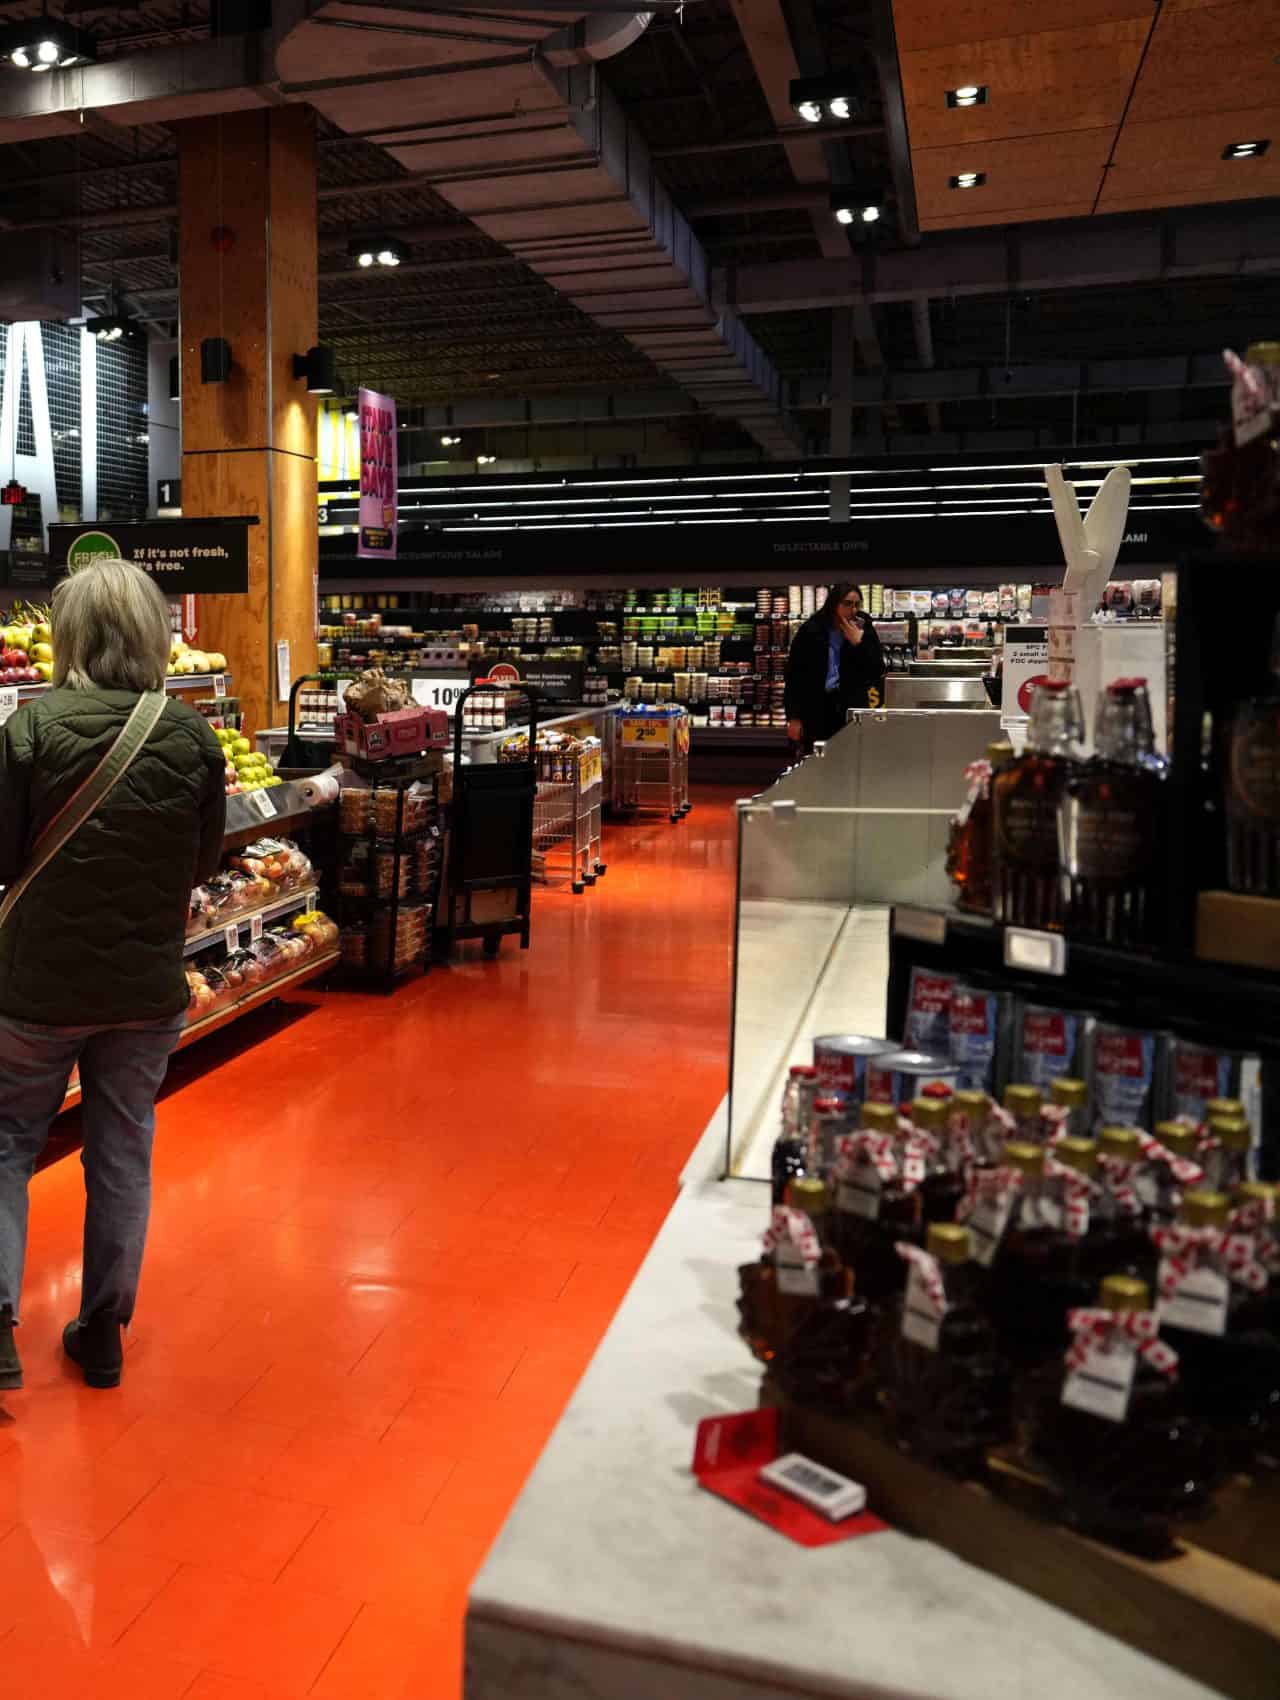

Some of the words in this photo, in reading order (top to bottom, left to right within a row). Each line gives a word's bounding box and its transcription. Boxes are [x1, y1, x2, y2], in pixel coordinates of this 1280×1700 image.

[160, 484, 170, 503] 1
[318, 507, 328, 523] 3
[133, 548, 145, 559] If
[147, 548, 167, 558] it's
[169, 547, 190, 558] not
[192, 545, 229, 559] fresh,
[155, 561, 185, 571] free.
